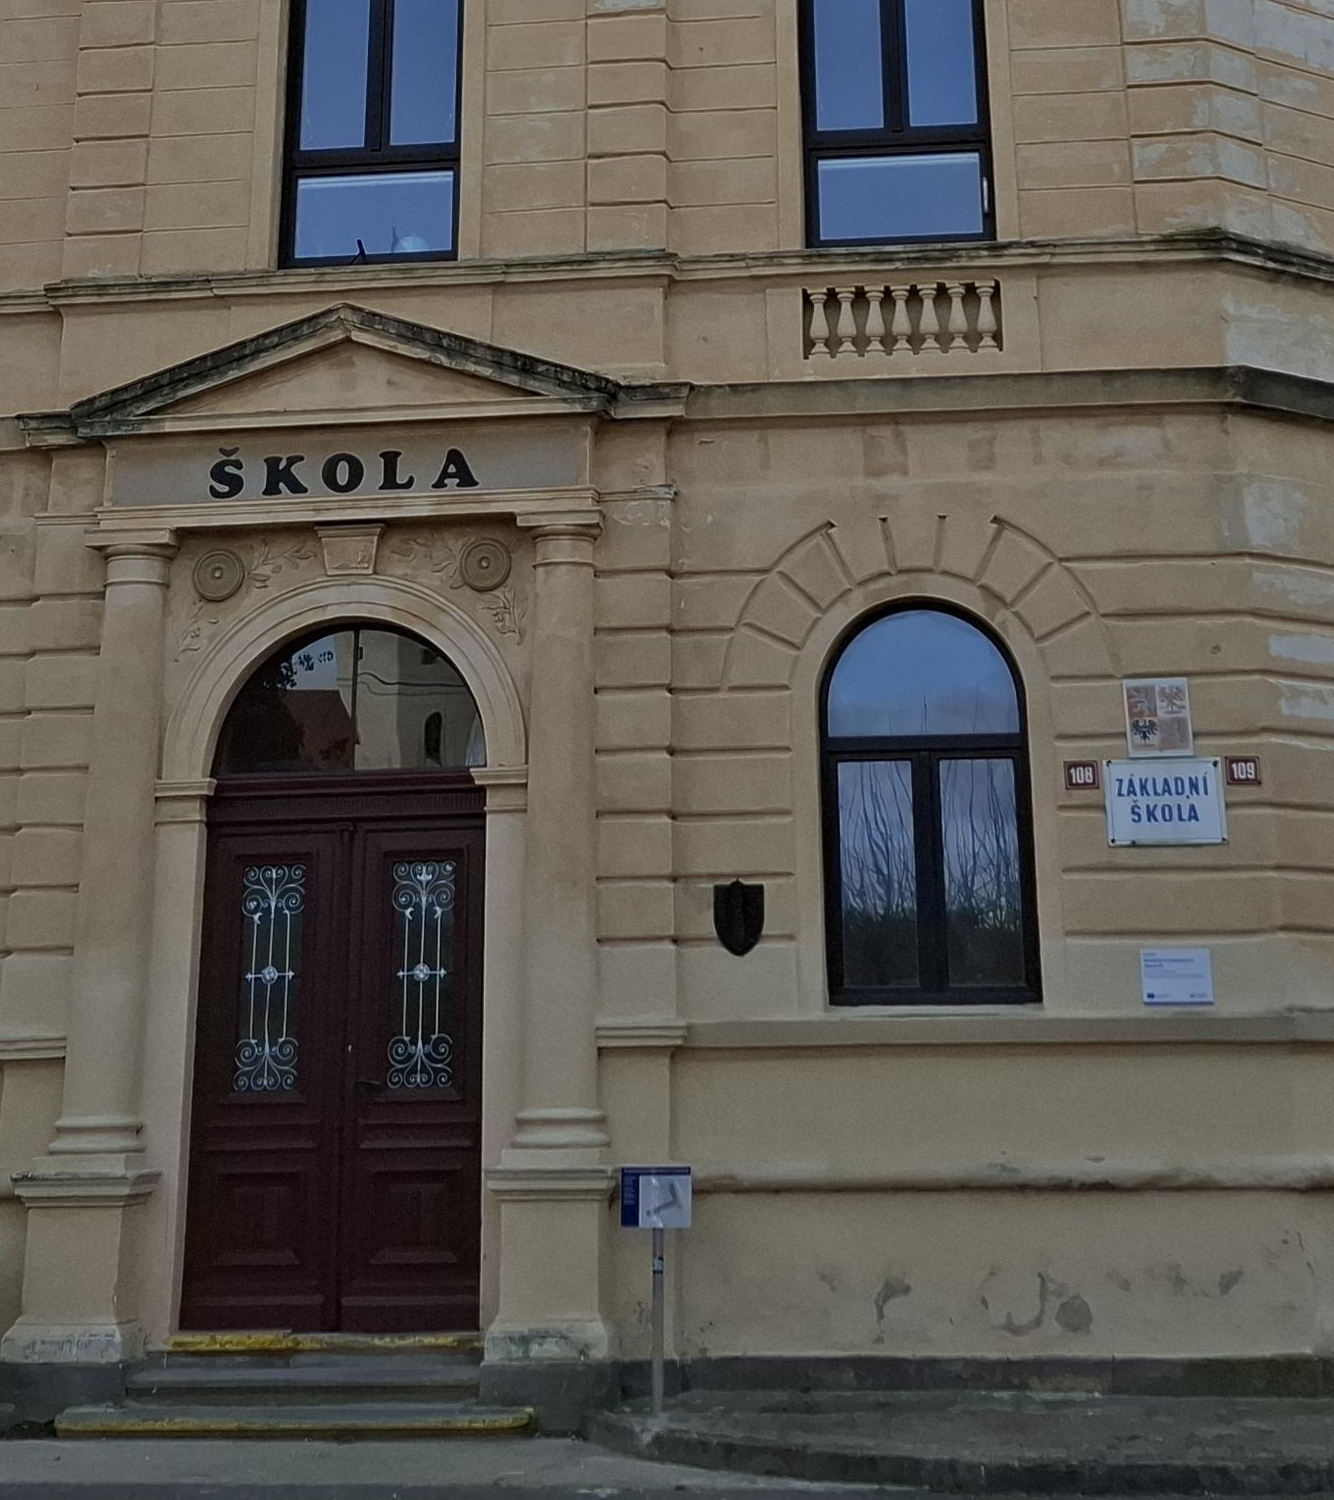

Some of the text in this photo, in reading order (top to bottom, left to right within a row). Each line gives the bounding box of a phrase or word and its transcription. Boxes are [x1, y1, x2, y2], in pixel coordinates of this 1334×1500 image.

[208, 446, 481, 500] ŠKOLA
[1069, 766, 1094, 784] 108
[1231, 761, 1255, 780] 109
[1115, 772, 1209, 798] ZÁKLADNÍ
[1130, 799, 1200, 823] ŠKOLA
